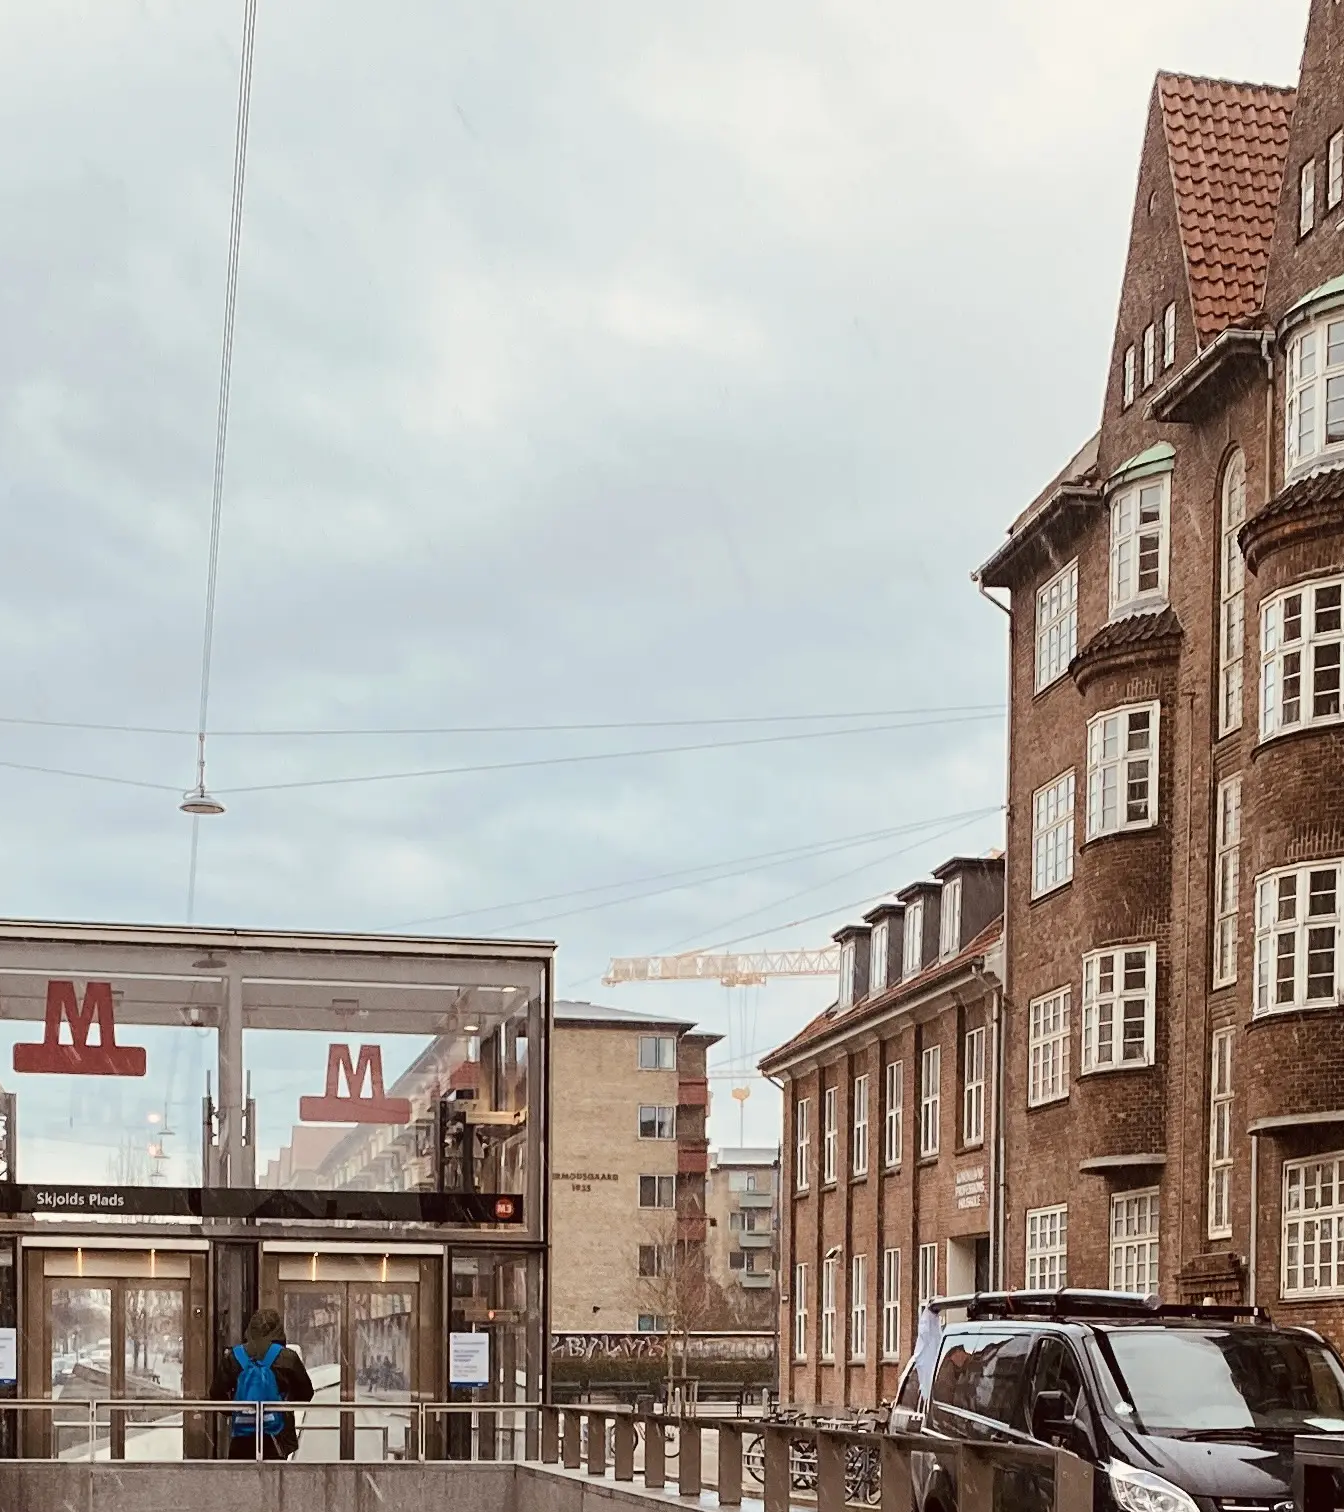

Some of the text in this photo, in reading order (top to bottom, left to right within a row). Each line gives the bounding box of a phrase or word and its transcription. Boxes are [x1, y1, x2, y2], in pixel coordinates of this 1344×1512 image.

[36, 1192, 125, 1207] Skjolds Plads
[496, 1204, 513, 1213] M3
